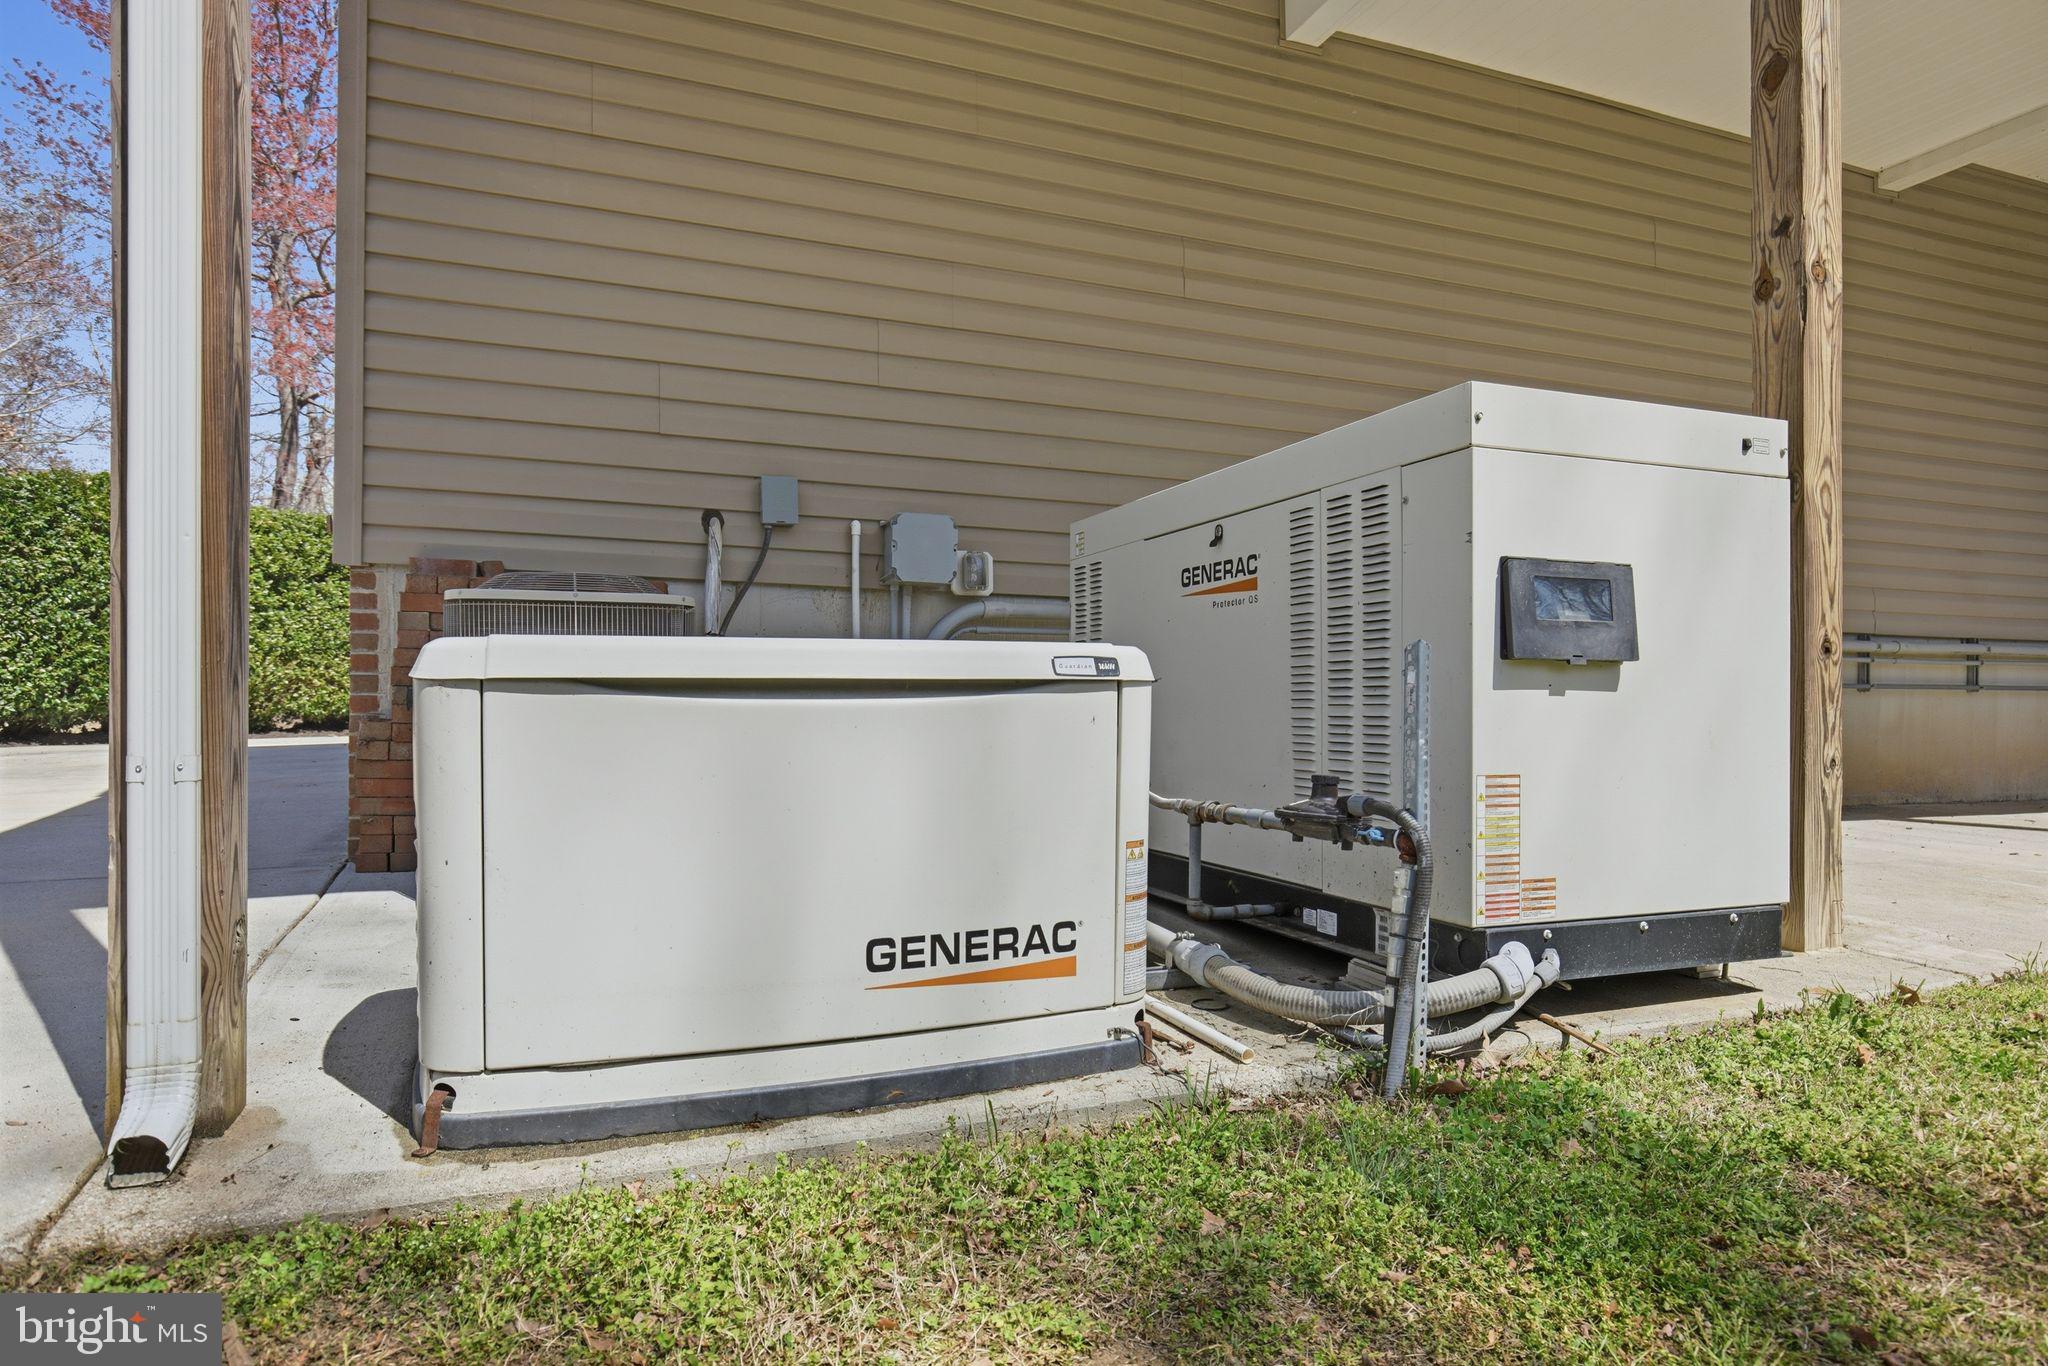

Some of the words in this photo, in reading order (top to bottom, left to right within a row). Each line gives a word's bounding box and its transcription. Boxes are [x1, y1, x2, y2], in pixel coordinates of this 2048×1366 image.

[1181, 554, 1258, 588] GENERAC
[1212, 597, 1245, 609] Protector
[865, 920, 1077, 973] GENERAC
